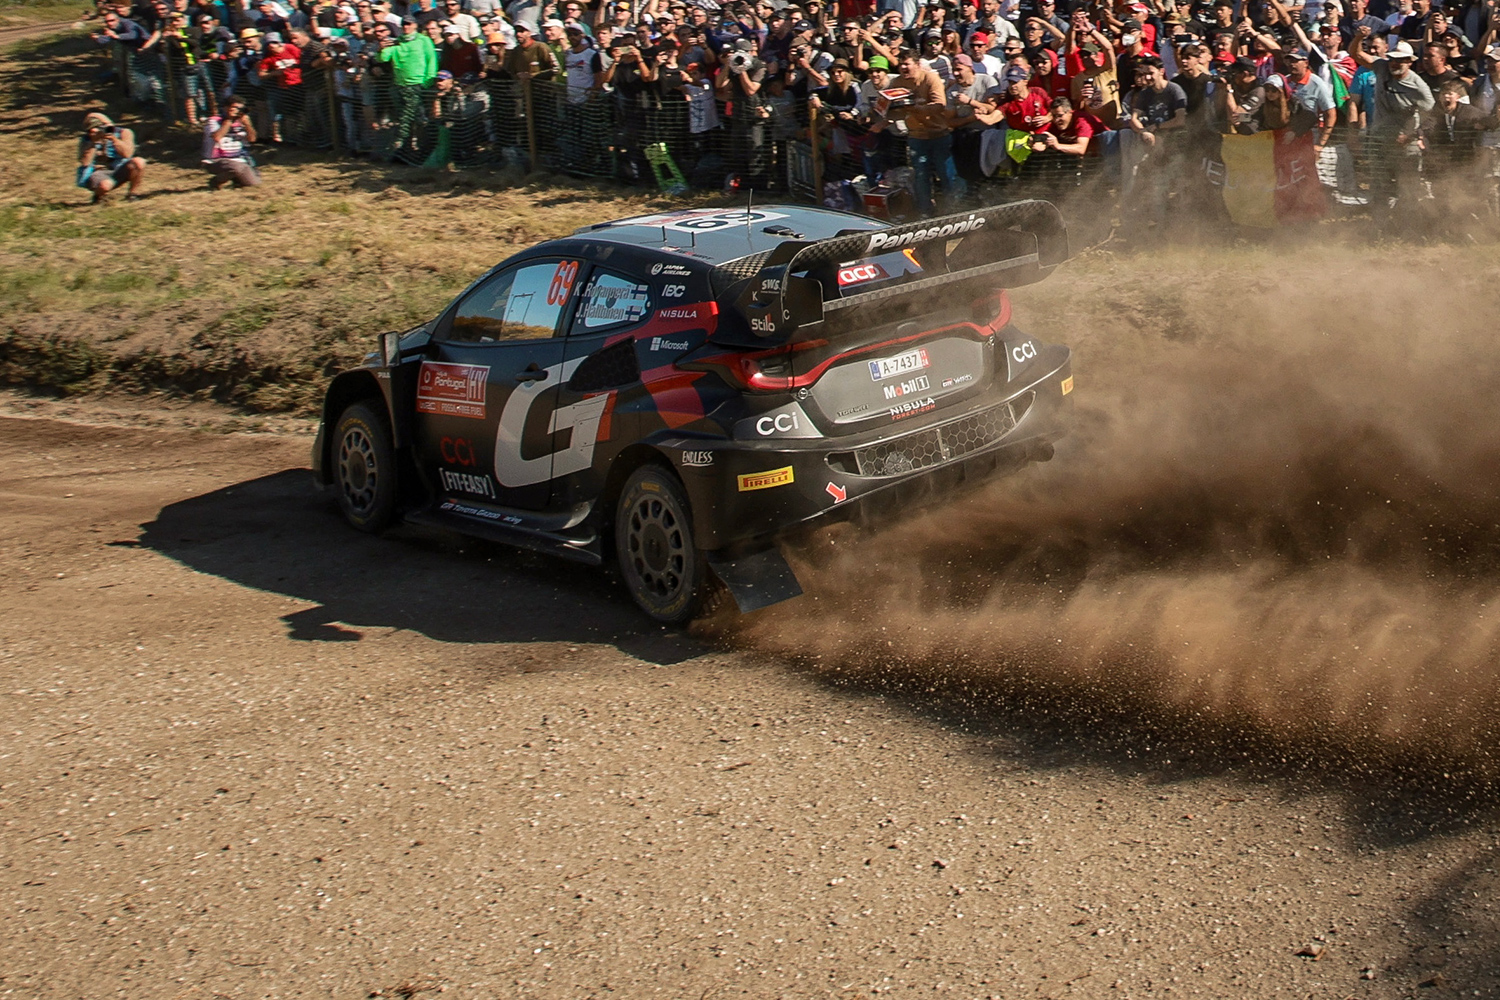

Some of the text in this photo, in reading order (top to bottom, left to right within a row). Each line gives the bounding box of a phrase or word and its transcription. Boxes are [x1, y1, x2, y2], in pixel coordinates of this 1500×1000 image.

[865, 214, 986, 253] Panasonic
[546, 260, 579, 306] 69
[659, 309, 697, 319] NISULA
[751, 313, 775, 332] Stilo
[661, 339, 689, 350] Microsoft
[883, 354, 917, 374] A-7437
[434, 376, 466, 391] Portugal
[469, 370, 486, 399] HY
[883, 379, 916, 400] Mobil
[889, 397, 935, 416] NISULA
[682, 451, 713, 464] ENDLESS
[743, 470, 789, 488] PIRELLI
